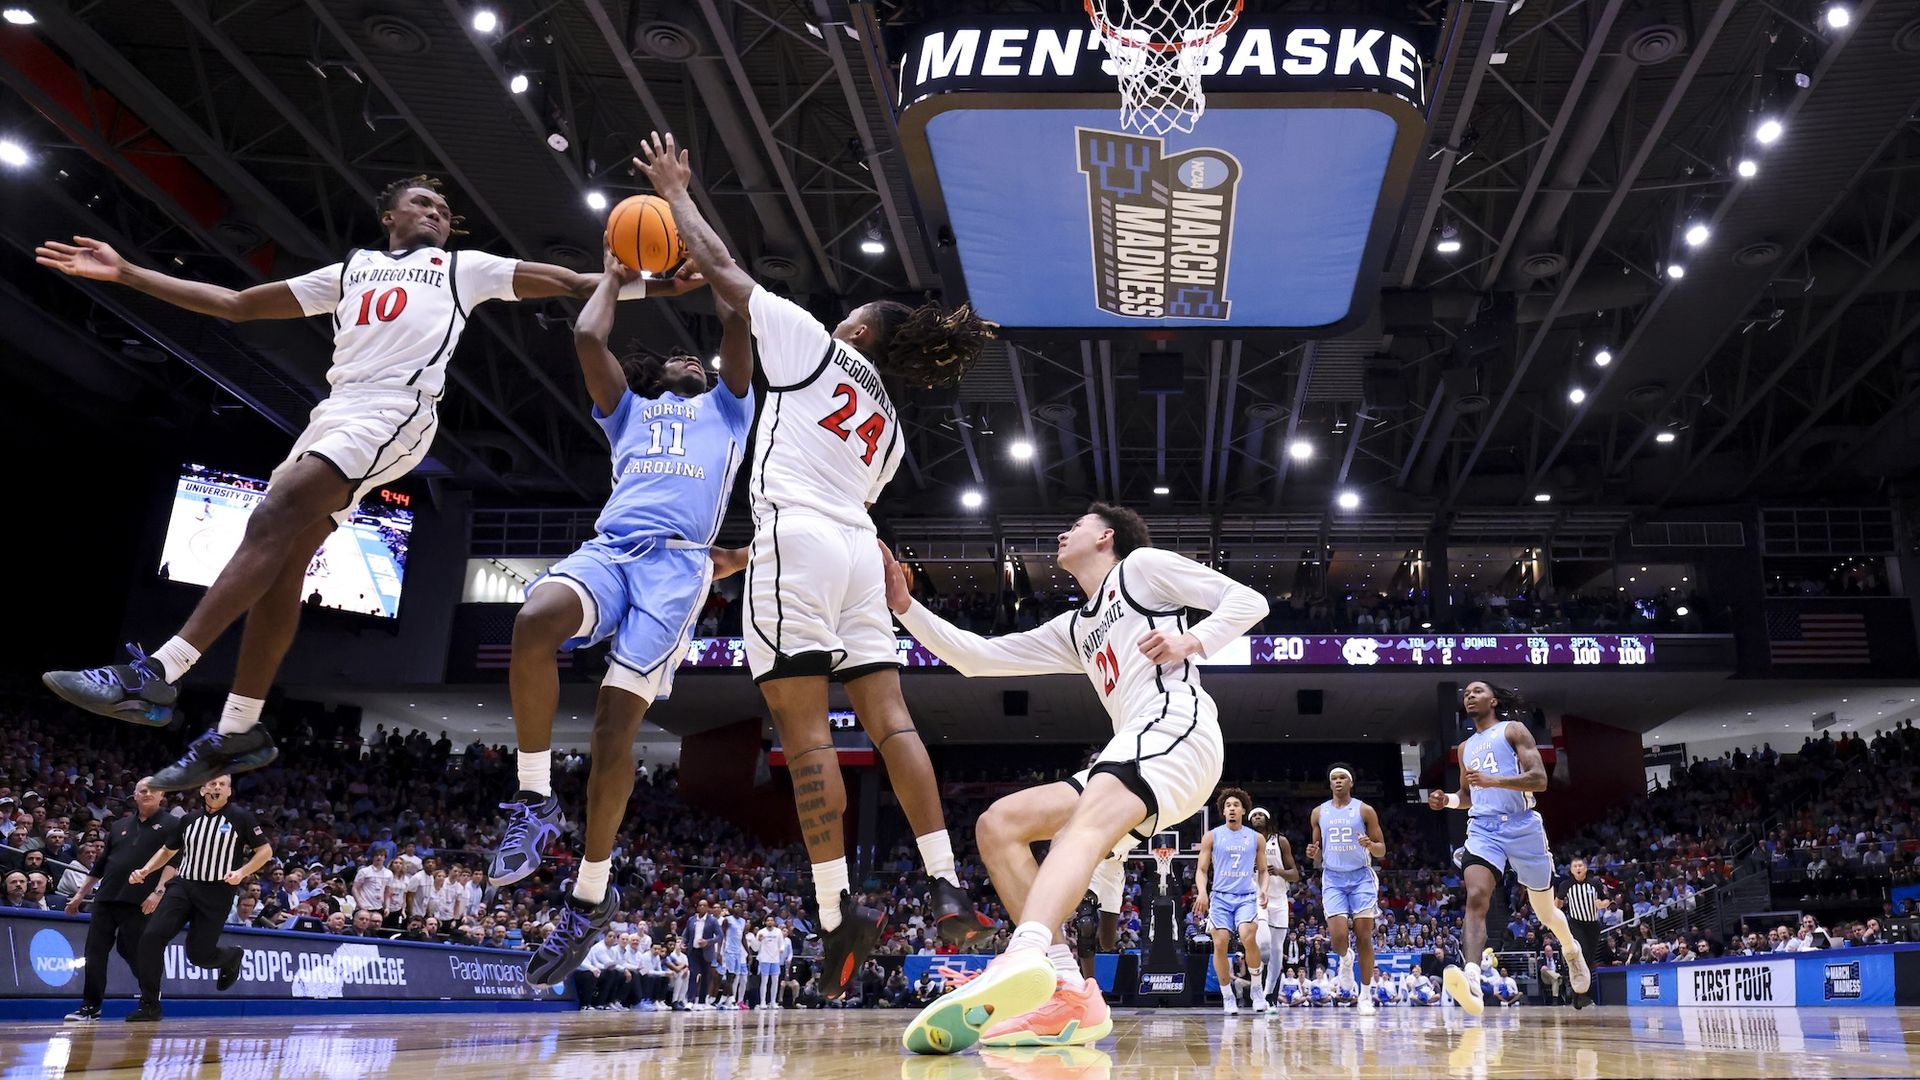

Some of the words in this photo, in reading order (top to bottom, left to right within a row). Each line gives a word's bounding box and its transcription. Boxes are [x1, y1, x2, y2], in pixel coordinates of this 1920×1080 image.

[915, 28, 1149, 86] MEN'S
[1177, 28, 1425, 104] BASKE
[1190, 160, 1205, 190] NCAA
[1170, 190, 1223, 285] MARCH
[1115, 203, 1166, 317] MADNESS
[349, 269, 371, 287] SAN
[369, 268, 406, 282] DIEGO
[406, 268, 445, 289] STATE
[355, 286, 408, 326] 10
[642, 403, 696, 423] NORTH
[817, 383, 886, 467] 24
[646, 421, 686, 456] 11
[624, 460, 706, 480] CAROLINA
[185, 482, 241, 501] UNIVERSITY
[243, 493, 255, 502] OF
[381, 489, 410, 505] 9:44
[896, 639, 913, 650] TOL
[1273, 637, 1304, 660] 20
[1408, 638, 1427, 648] TOL
[1437, 638, 1454, 648] FLS
[1464, 638, 1497, 648] BONUS
[1527, 638, 1548, 648] FG%
[1570, 638, 1598, 648] 3PT%
[1620, 638, 1641, 648] FT%
[1412, 648, 1423, 665] 4
[1442, 648, 1452, 665] 2
[1531, 648, 1549, 665] 67
[1572, 648, 1600, 665] 100
[1618, 648, 1646, 665] 100
[1096, 639, 1120, 697] 21
[1328, 827, 1353, 843] 22
[1230, 853, 1241, 869] 7
[237, 949, 406, 986] SOPC.ORG/COLLEGE
[449, 955, 525, 986] Paralympians
[1830, 965, 1850, 980] MARCH
[1150, 975, 1173, 983] MARCH
[1152, 982, 1184, 990] MADNESS
[1693, 968, 1731, 1001] FIRST
[1734, 966, 1773, 1001] FOUR
[1833, 979, 1861, 993] MADNESS
[474, 986, 496, 994] MADE
[497, 986, 516, 995] HERE
